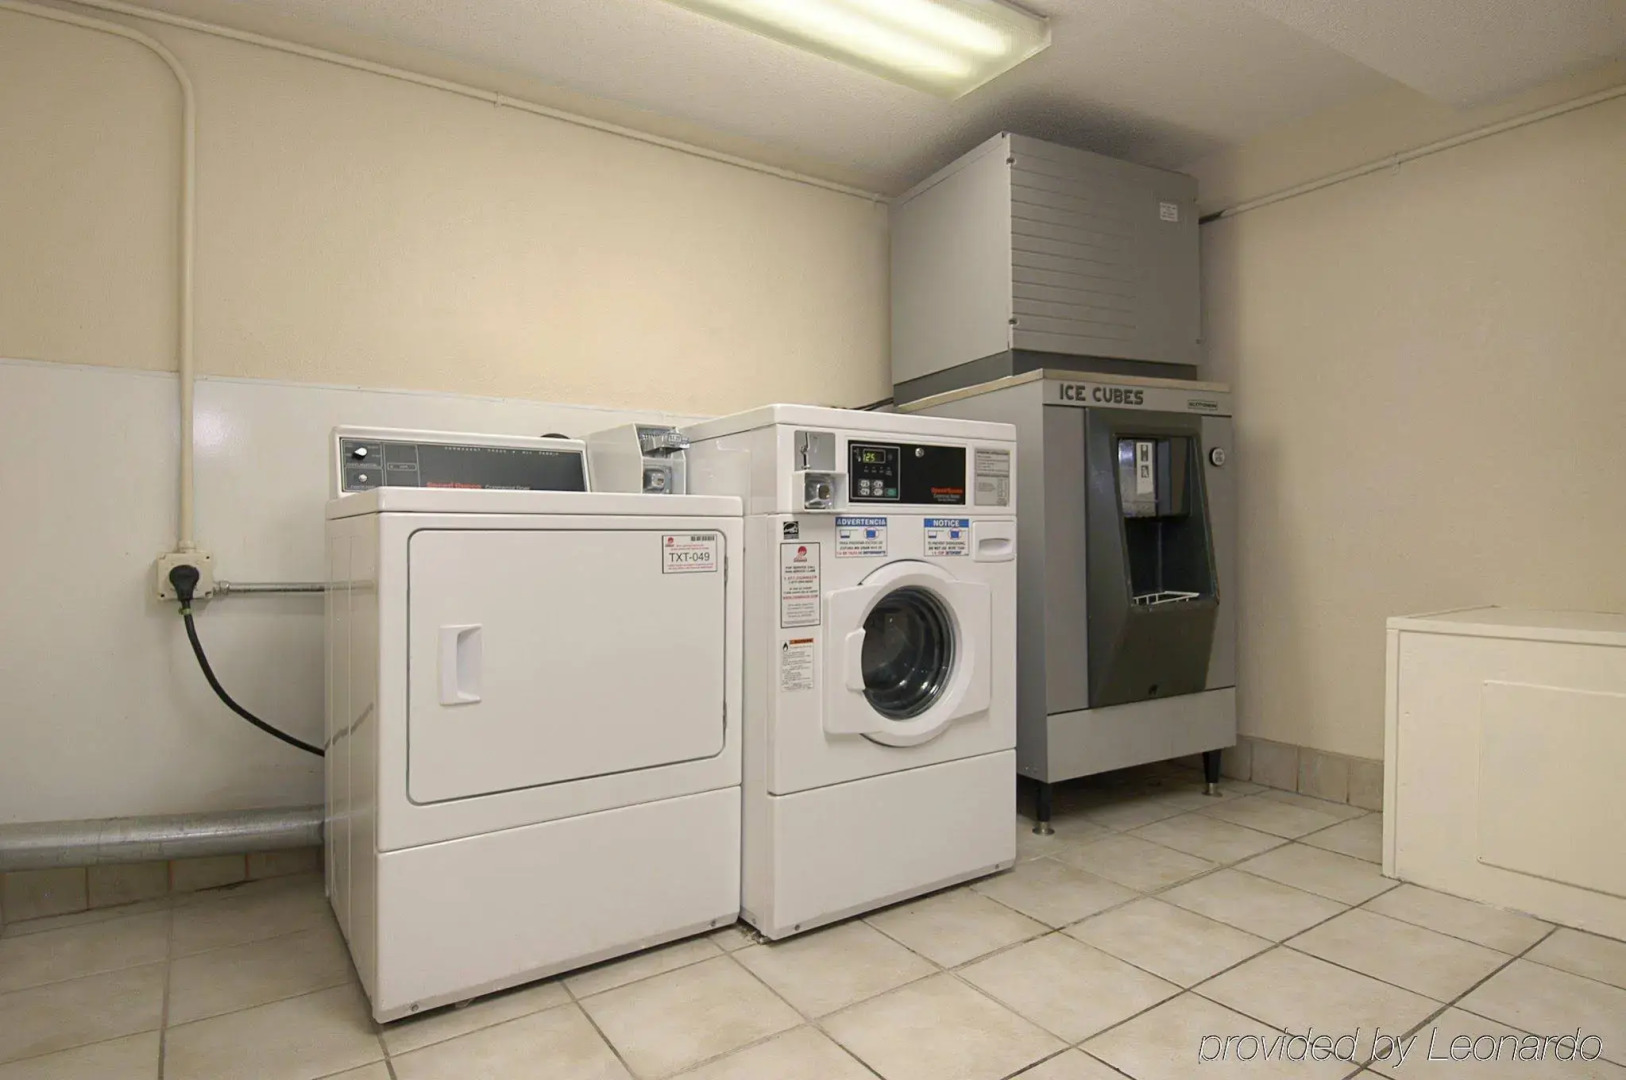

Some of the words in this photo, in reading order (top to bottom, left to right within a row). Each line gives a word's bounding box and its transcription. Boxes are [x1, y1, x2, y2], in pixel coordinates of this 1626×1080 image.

[1060, 383, 1086, 401] ICE
[1092, 387, 1144, 405] CUBES
[836, 518, 887, 526] ADVERTENCIA
[933, 519, 960, 527] NOTICE
[668, 552, 710, 562] TXT-049
